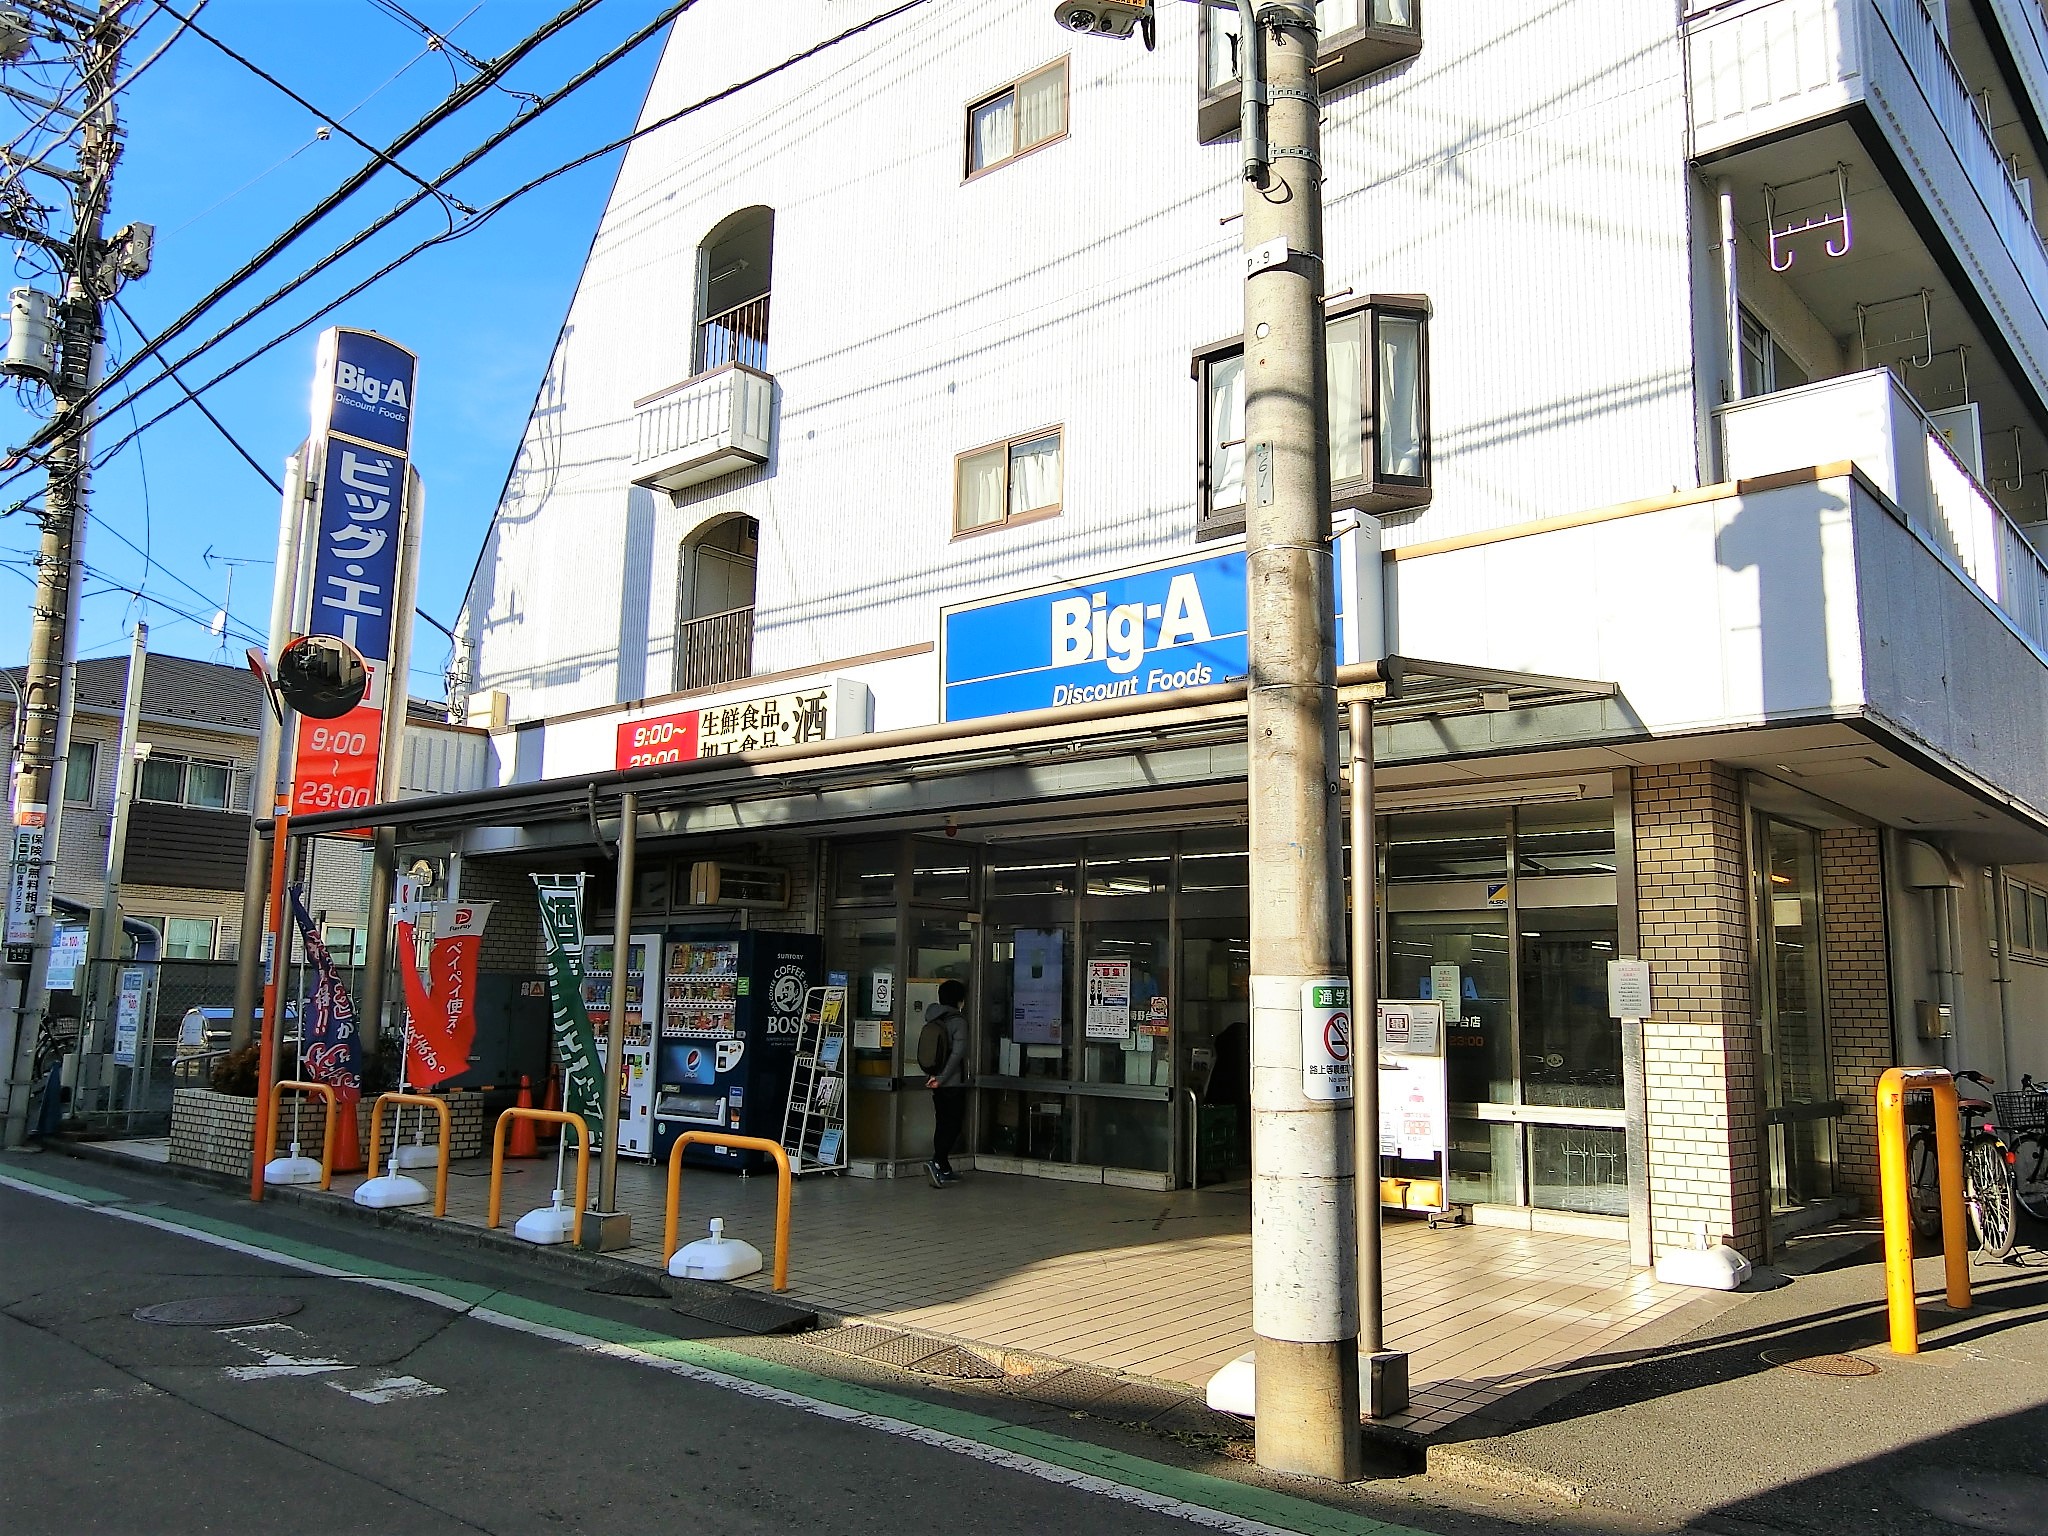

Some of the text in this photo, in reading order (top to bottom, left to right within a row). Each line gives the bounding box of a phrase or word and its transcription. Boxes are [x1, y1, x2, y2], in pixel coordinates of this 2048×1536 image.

[336, 360, 408, 409] Big-A
[335, 392, 406, 423] Discount Foods
[1051, 572, 1212, 674] Big-A
[1052, 662, 1212, 707] Discount Foods
[701, 700, 780, 738] 生鮮食品
[311, 727, 366, 756] 9:00
[298, 781, 371, 809] 23:00
[777, 952, 804, 960] SUNTORY
[774, 964, 806, 981] COFFEE
[446, 941, 464, 1036] ペイペイ使え
[1318, 989, 1351, 1006] 通学
[1456, 1015, 1482, 1028] 台店
[1310, 1064, 1349, 1075] 路上等喫煙
